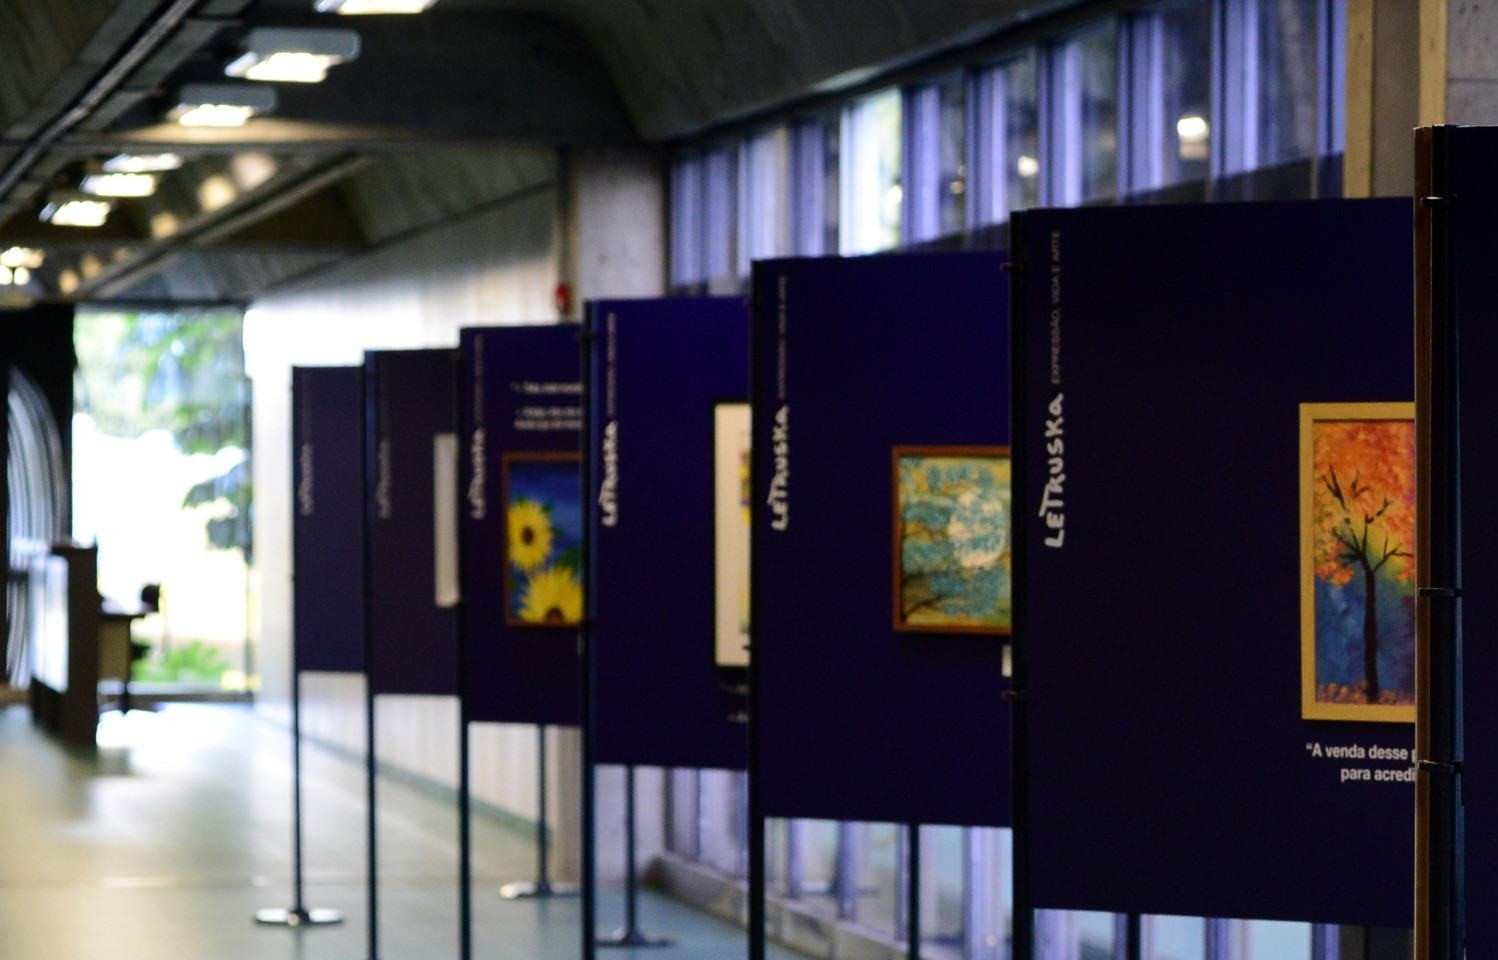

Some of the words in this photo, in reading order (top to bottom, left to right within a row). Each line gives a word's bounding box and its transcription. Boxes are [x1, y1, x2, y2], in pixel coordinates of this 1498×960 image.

[1039, 393, 1066, 548] LETRUSKA
[1325, 744, 1366, 759] venda
[1368, 745, 1409, 760] desse
[1341, 768, 1371, 782] para
